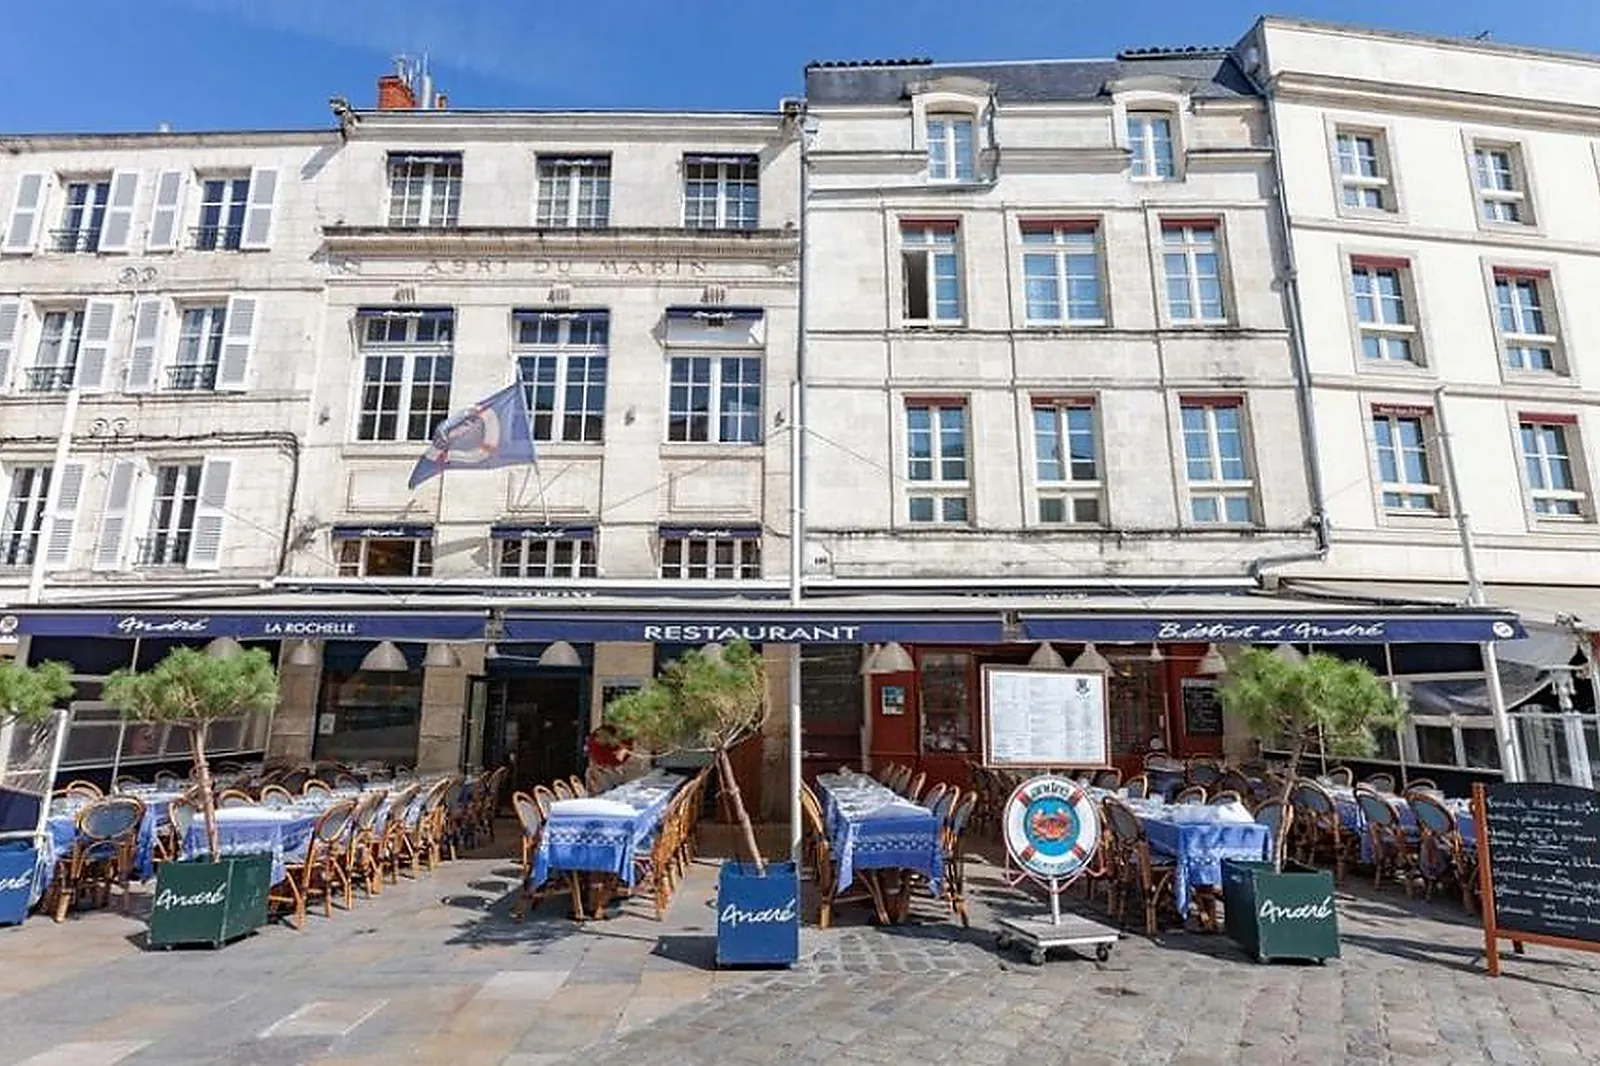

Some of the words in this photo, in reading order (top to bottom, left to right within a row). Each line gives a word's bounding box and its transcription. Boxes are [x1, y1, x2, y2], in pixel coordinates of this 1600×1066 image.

[533, 259, 573, 274] DU
[599, 259, 707, 275] MARIN
[117, 616, 211, 634] André
[265, 622, 281, 633] LA
[284, 622, 356, 634] ROCHELLE
[643, 625, 860, 641] RESTAURANT
[1158, 621, 1260, 640] Bistrot
[1261, 622, 1385, 639] d'André
[156, 882, 227, 911] André
[721, 897, 796, 928] André
[1260, 895, 1333, 923] André
